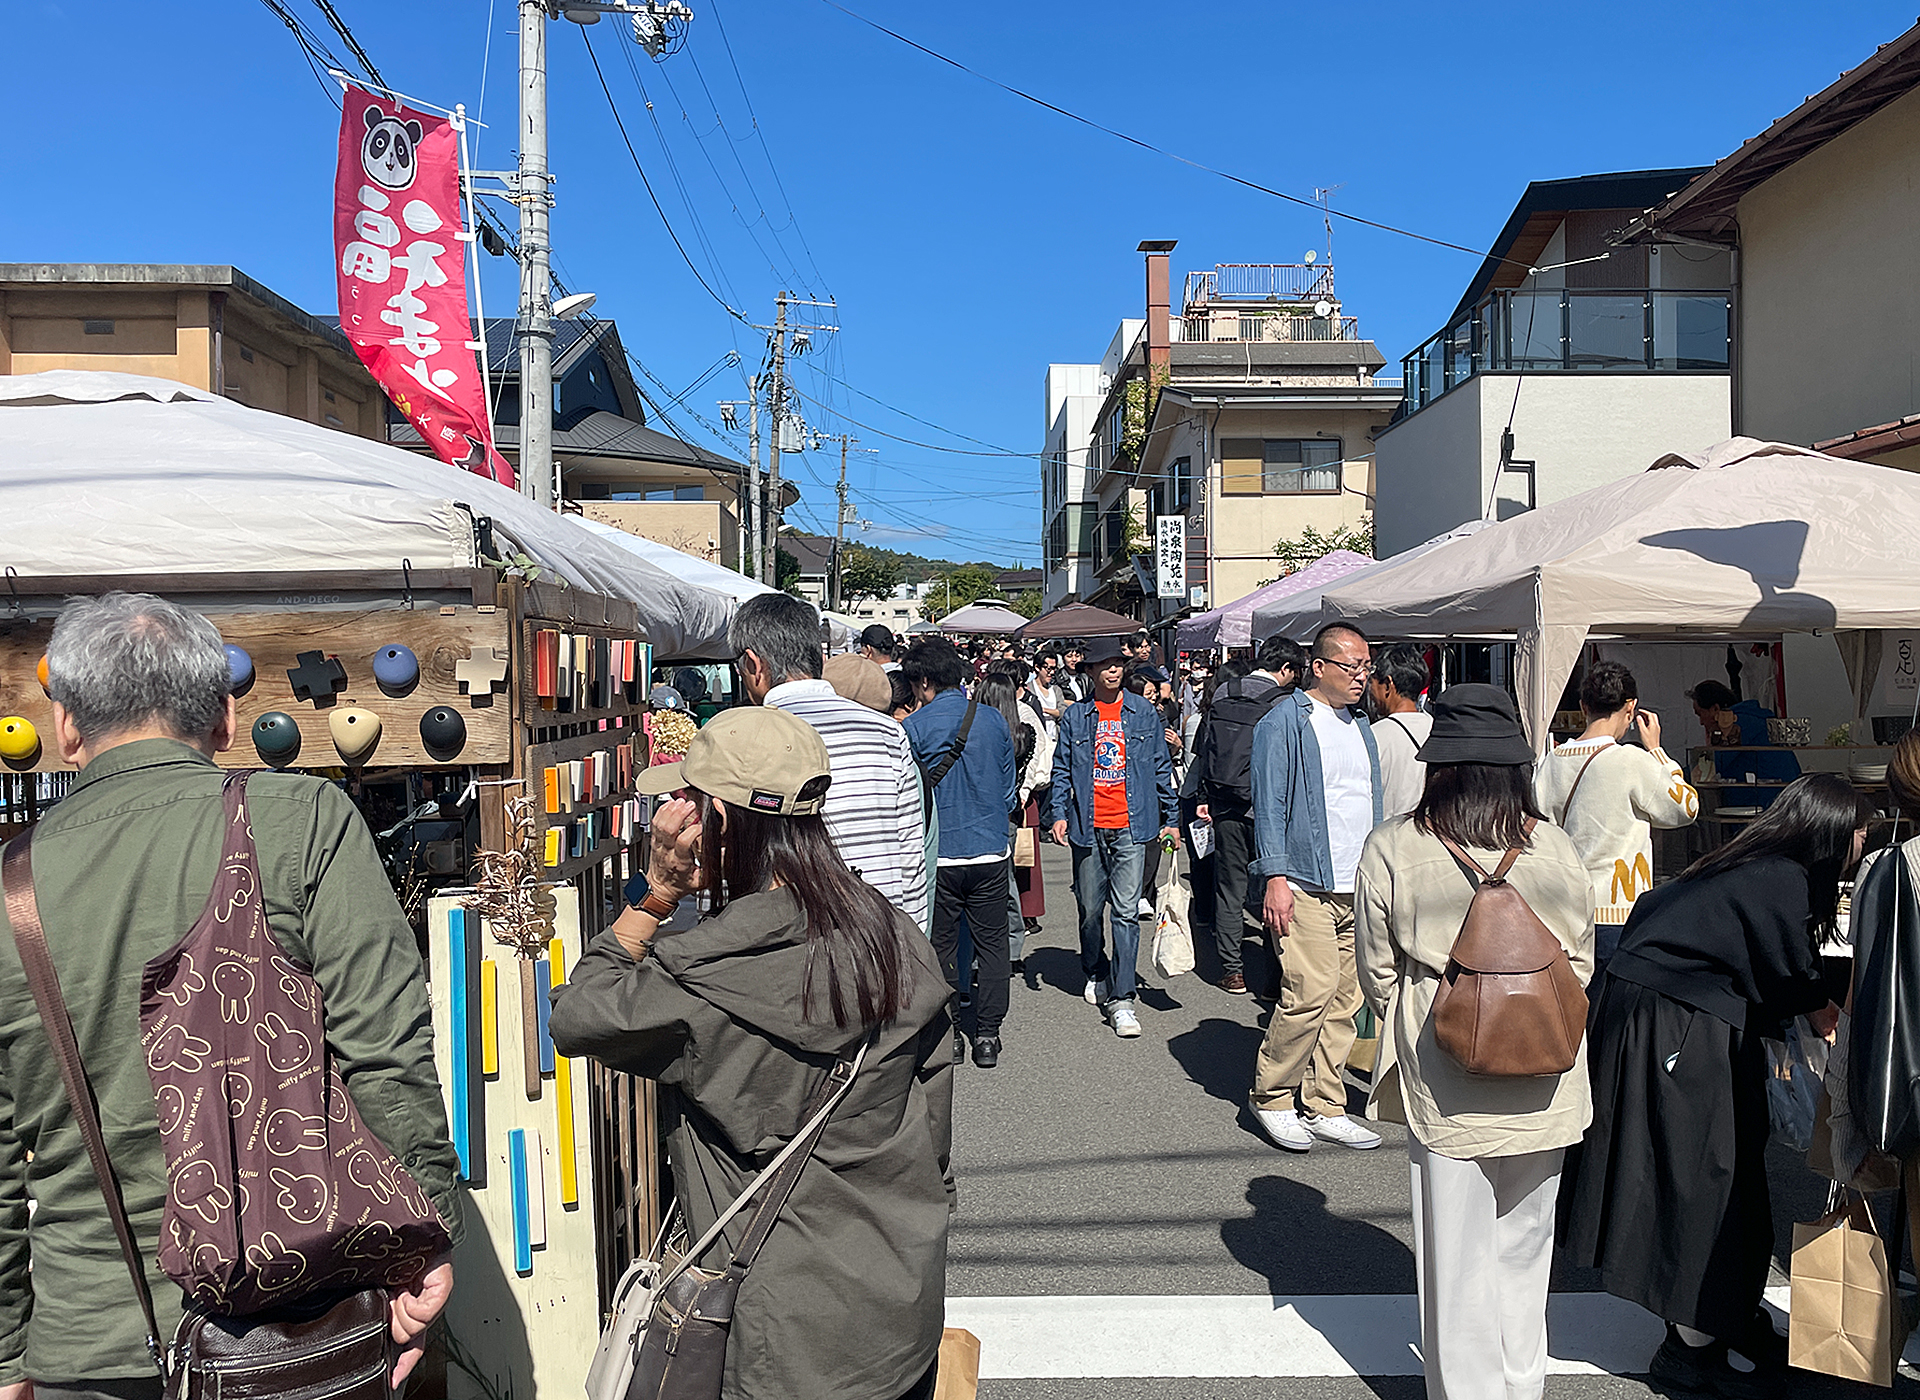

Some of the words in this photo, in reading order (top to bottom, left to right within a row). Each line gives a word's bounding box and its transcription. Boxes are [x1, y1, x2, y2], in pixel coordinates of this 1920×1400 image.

[1093, 768, 1126, 779] RONCOS
[242, 954, 259, 963] miffy
[151, 1014, 168, 1033] miffy
[141, 1032, 153, 1045] and
[278, 1076, 298, 1089] miffy
[299, 1068, 312, 1079] and
[193, 1087, 204, 1101] dan
[190, 1103, 198, 1118] and
[257, 1098, 268, 1118] miffy
[183, 1120, 195, 1141] miffy
[253, 1120, 261, 1134] and
[183, 1141, 203, 1158] miffy
[247, 1136, 256, 1150] dan
[238, 1169, 258, 1178] miffy
[327, 1211, 338, 1232] miffy
[358, 1207, 370, 1225] miffy
